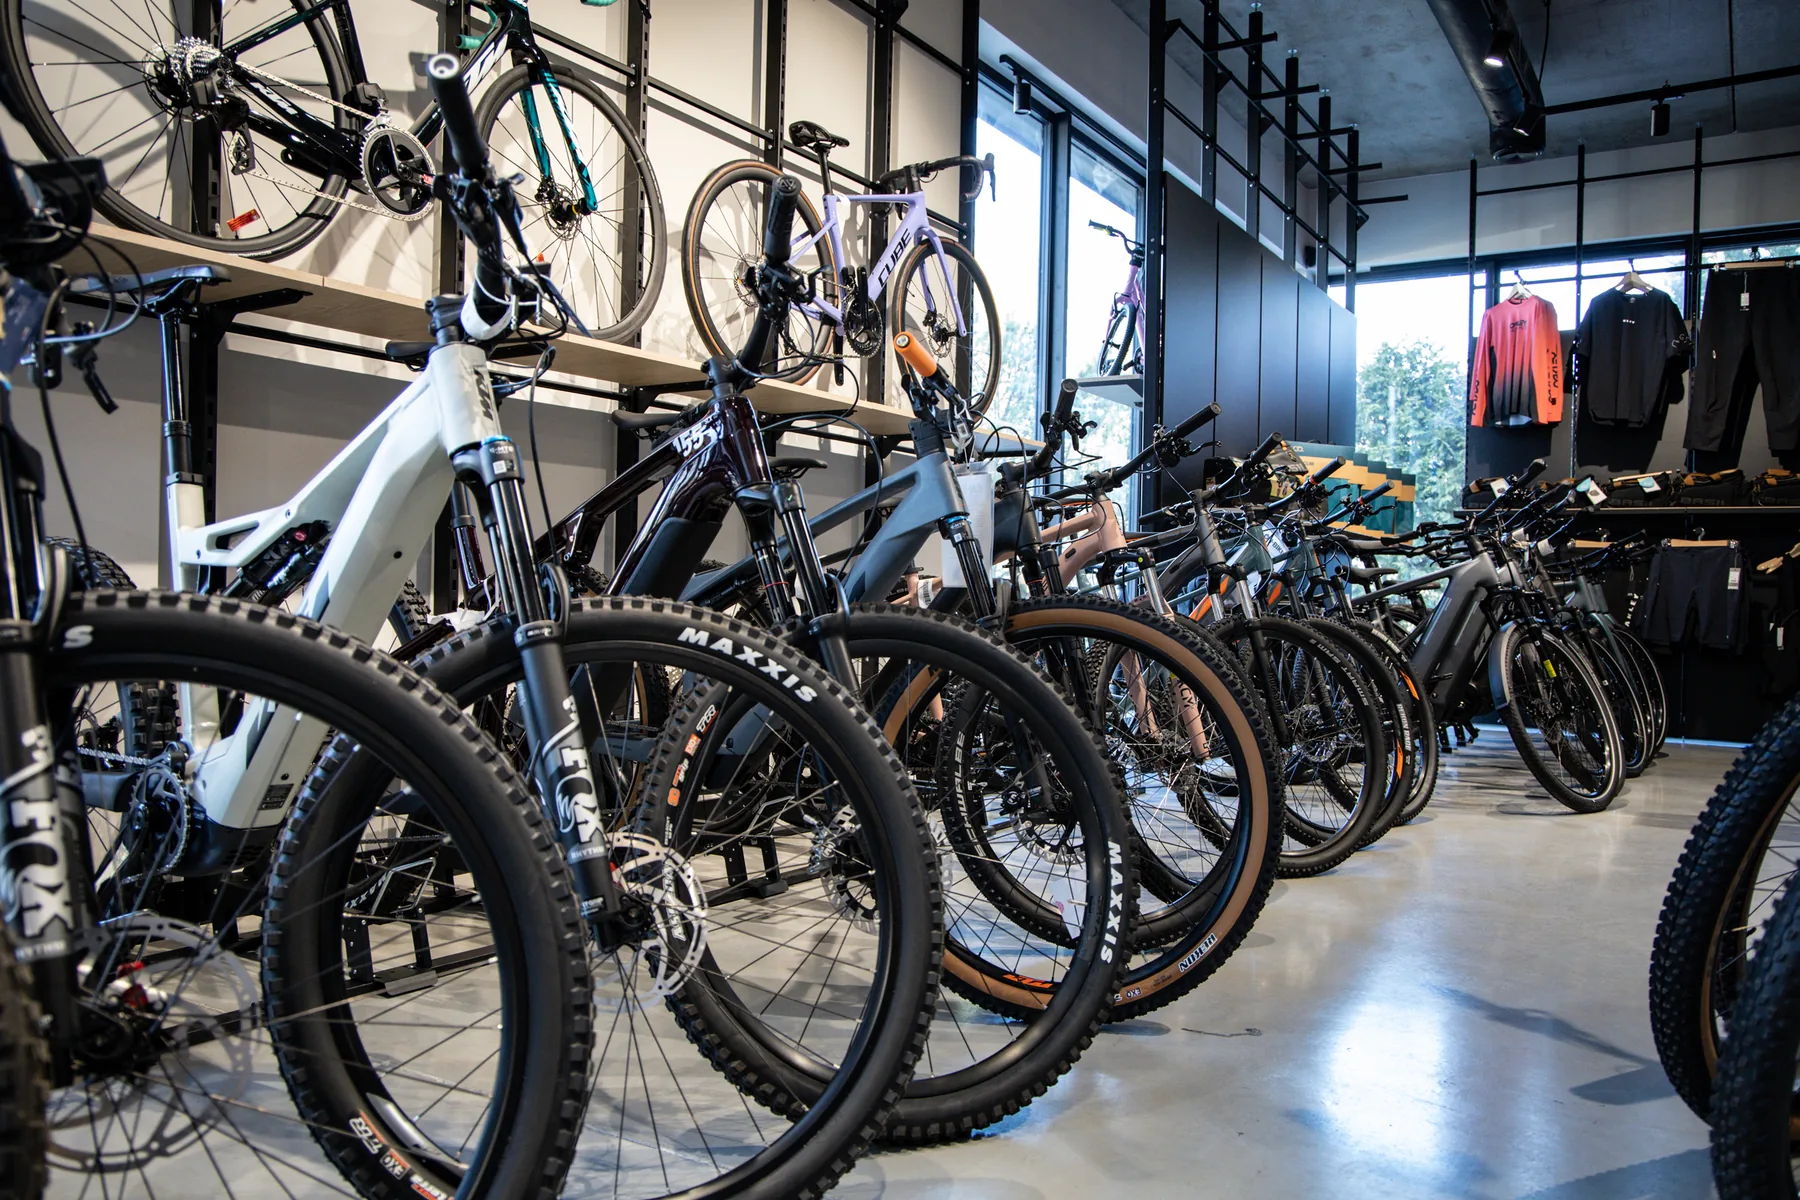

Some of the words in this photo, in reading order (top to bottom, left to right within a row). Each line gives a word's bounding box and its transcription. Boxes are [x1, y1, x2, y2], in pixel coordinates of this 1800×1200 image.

[463, 33, 508, 96] TM
[250, 82, 298, 115] KTM
[878, 228, 911, 287] CUBE
[474, 367, 494, 421] KTM
[1680, 496, 1725, 506] BASIL
[1625, 593, 1639, 627] AKLEY
[677, 627, 818, 702] MAXXIS
[955, 731, 986, 857] SCHWALBE
[345, 871, 387, 908] MAXXI
[1101, 841, 1123, 963] MAXXIS
[382, 1153, 406, 1178] EXO
